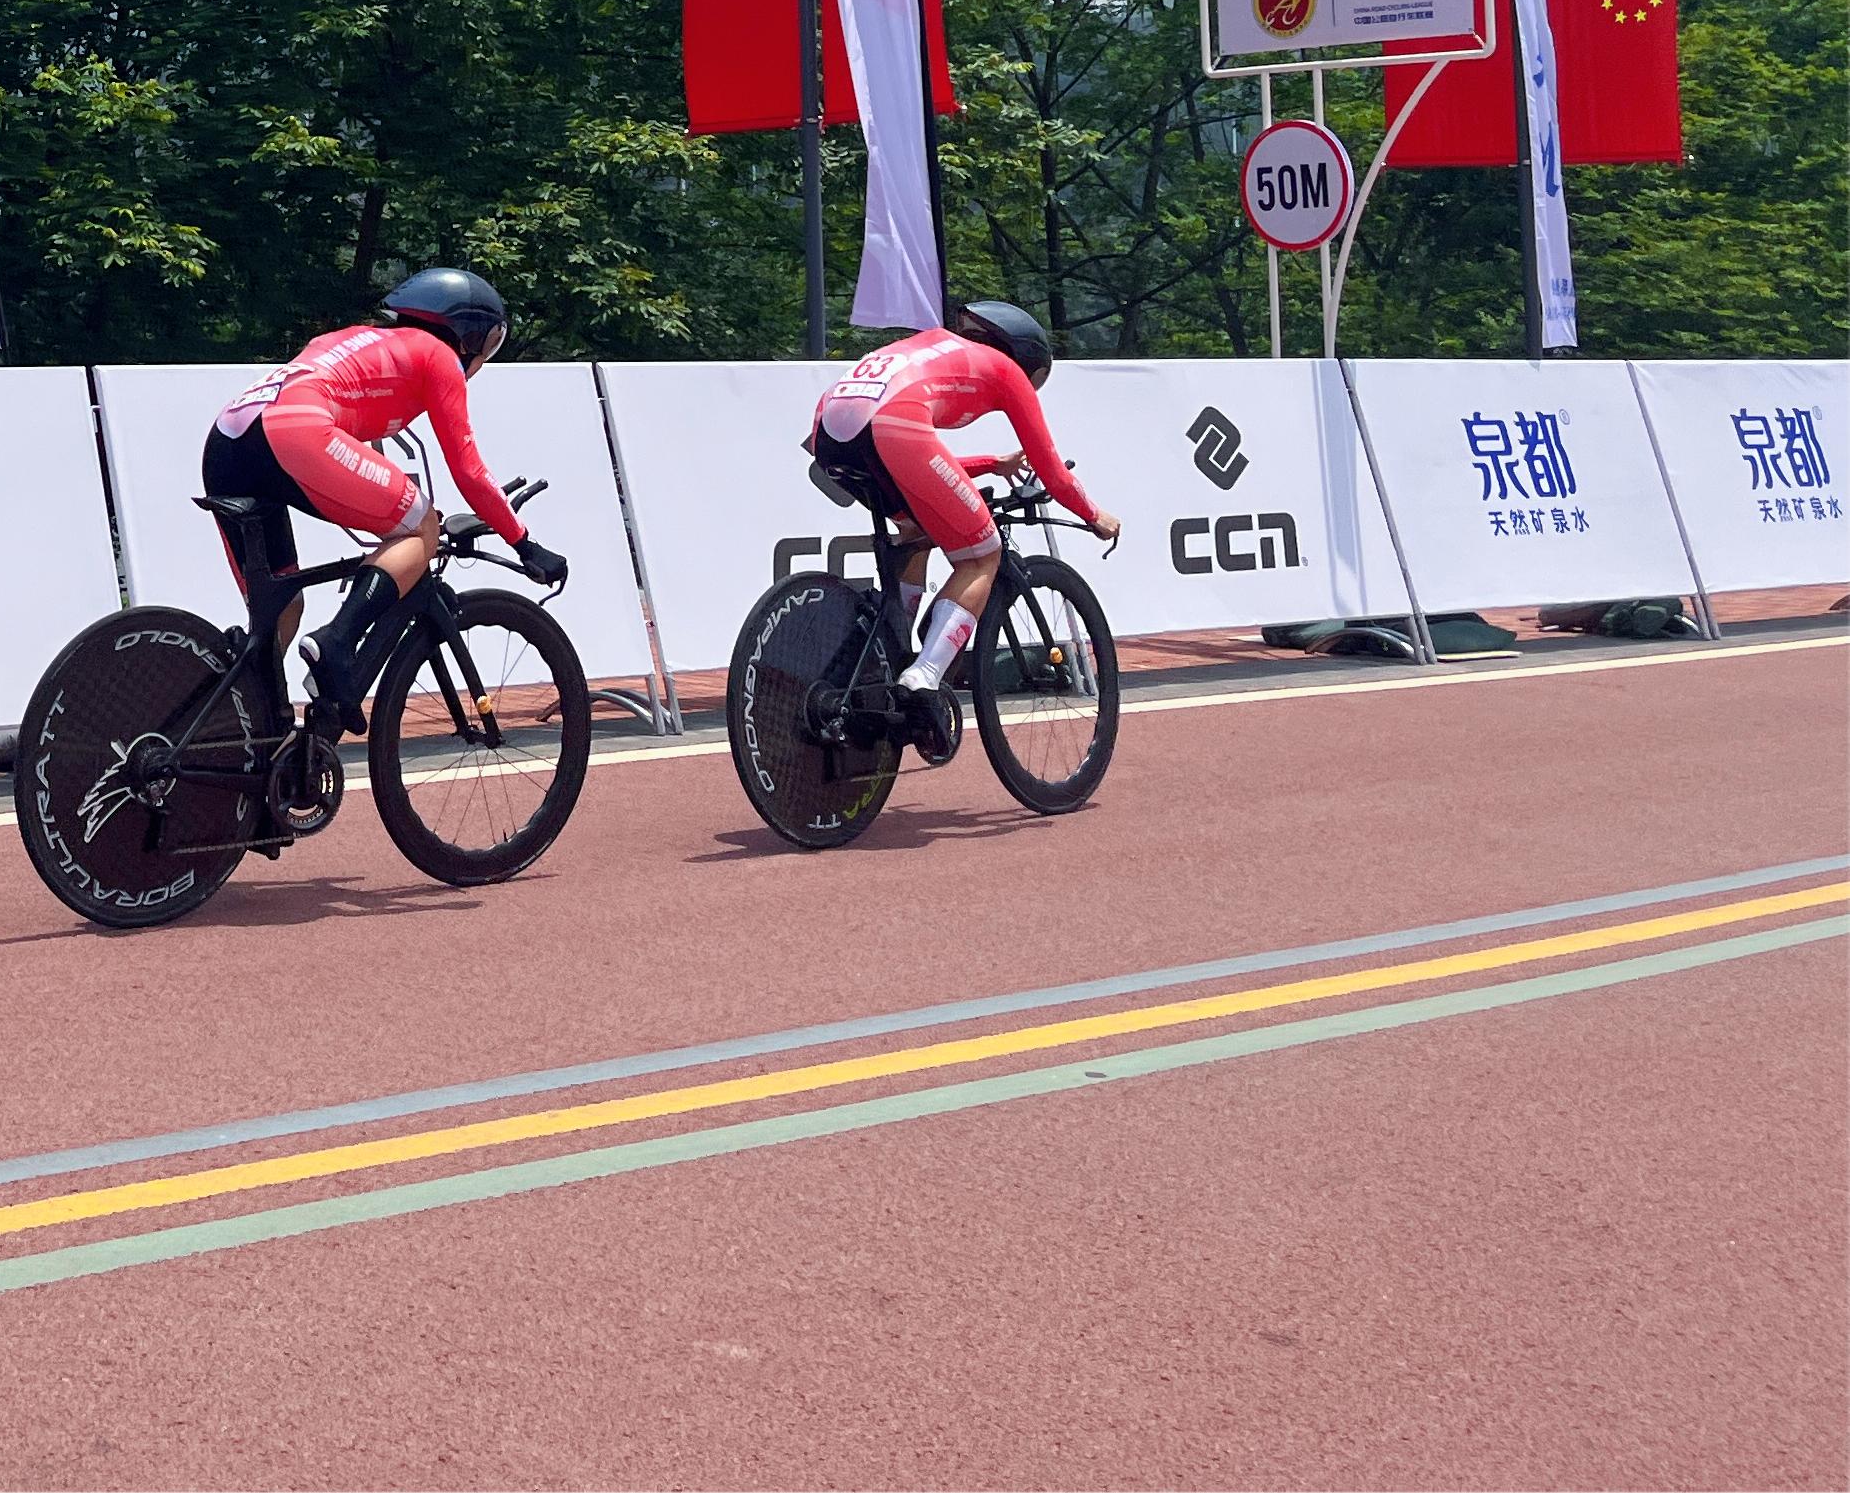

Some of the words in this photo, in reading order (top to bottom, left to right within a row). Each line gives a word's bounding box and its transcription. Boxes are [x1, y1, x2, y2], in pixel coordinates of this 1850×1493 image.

[1256, 163, 1330, 211] 50M
[853, 356, 894, 379] 63
[325, 437, 360, 472] HONG
[357, 457, 391, 487] KONG
[1461, 409, 1577, 501] 泉都
[1730, 404, 1832, 491] 泉都
[1488, 508, 1590, 538] 天然矿泉水
[1757, 498, 1843, 524] 天然矿泉水
[744, 589, 825, 793] CAMPAGNOLO
